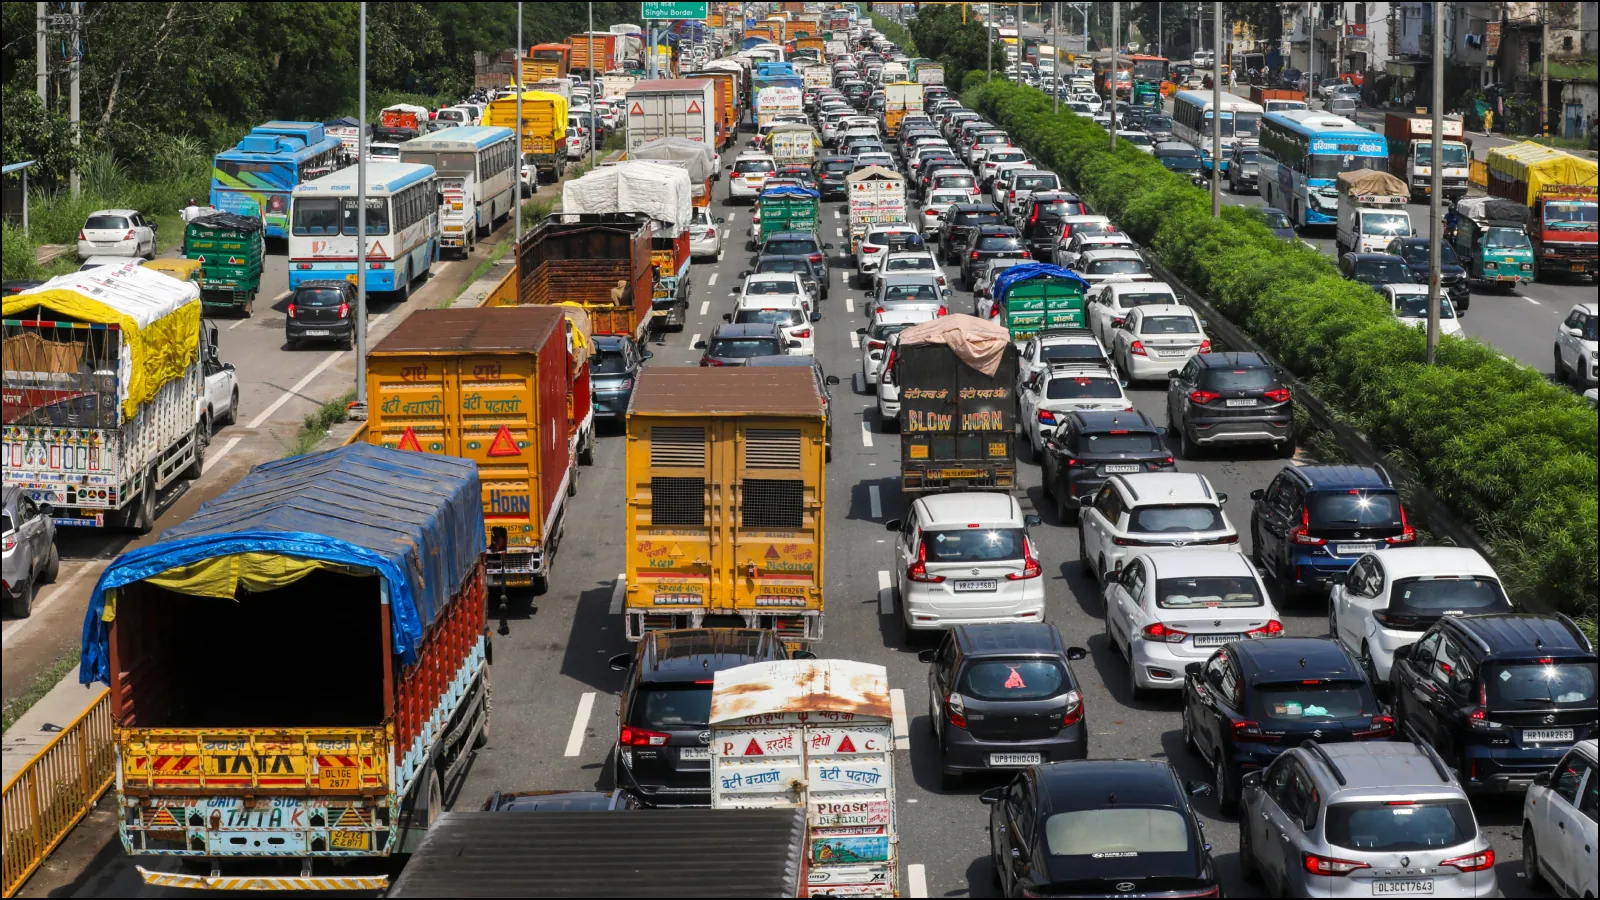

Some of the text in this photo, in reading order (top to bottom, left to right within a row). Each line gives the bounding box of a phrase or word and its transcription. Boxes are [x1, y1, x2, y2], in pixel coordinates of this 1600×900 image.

[1313, 141, 1337, 150] हरियाणा
[909, 410, 1002, 432] BLOW HORN
[490, 489, 530, 513] HORN
[766, 561, 813, 571] Distance
[212, 756, 295, 774] TATA
[820, 767, 841, 780] बेटी
[330, 779, 350, 787] 2877
[720, 772, 742, 790] बेटी
[817, 803, 867, 814] Please
[818, 814, 866, 825] Distance
[871, 873, 886, 882] XL
[1378, 882, 1432, 892] DL3CCT7643
